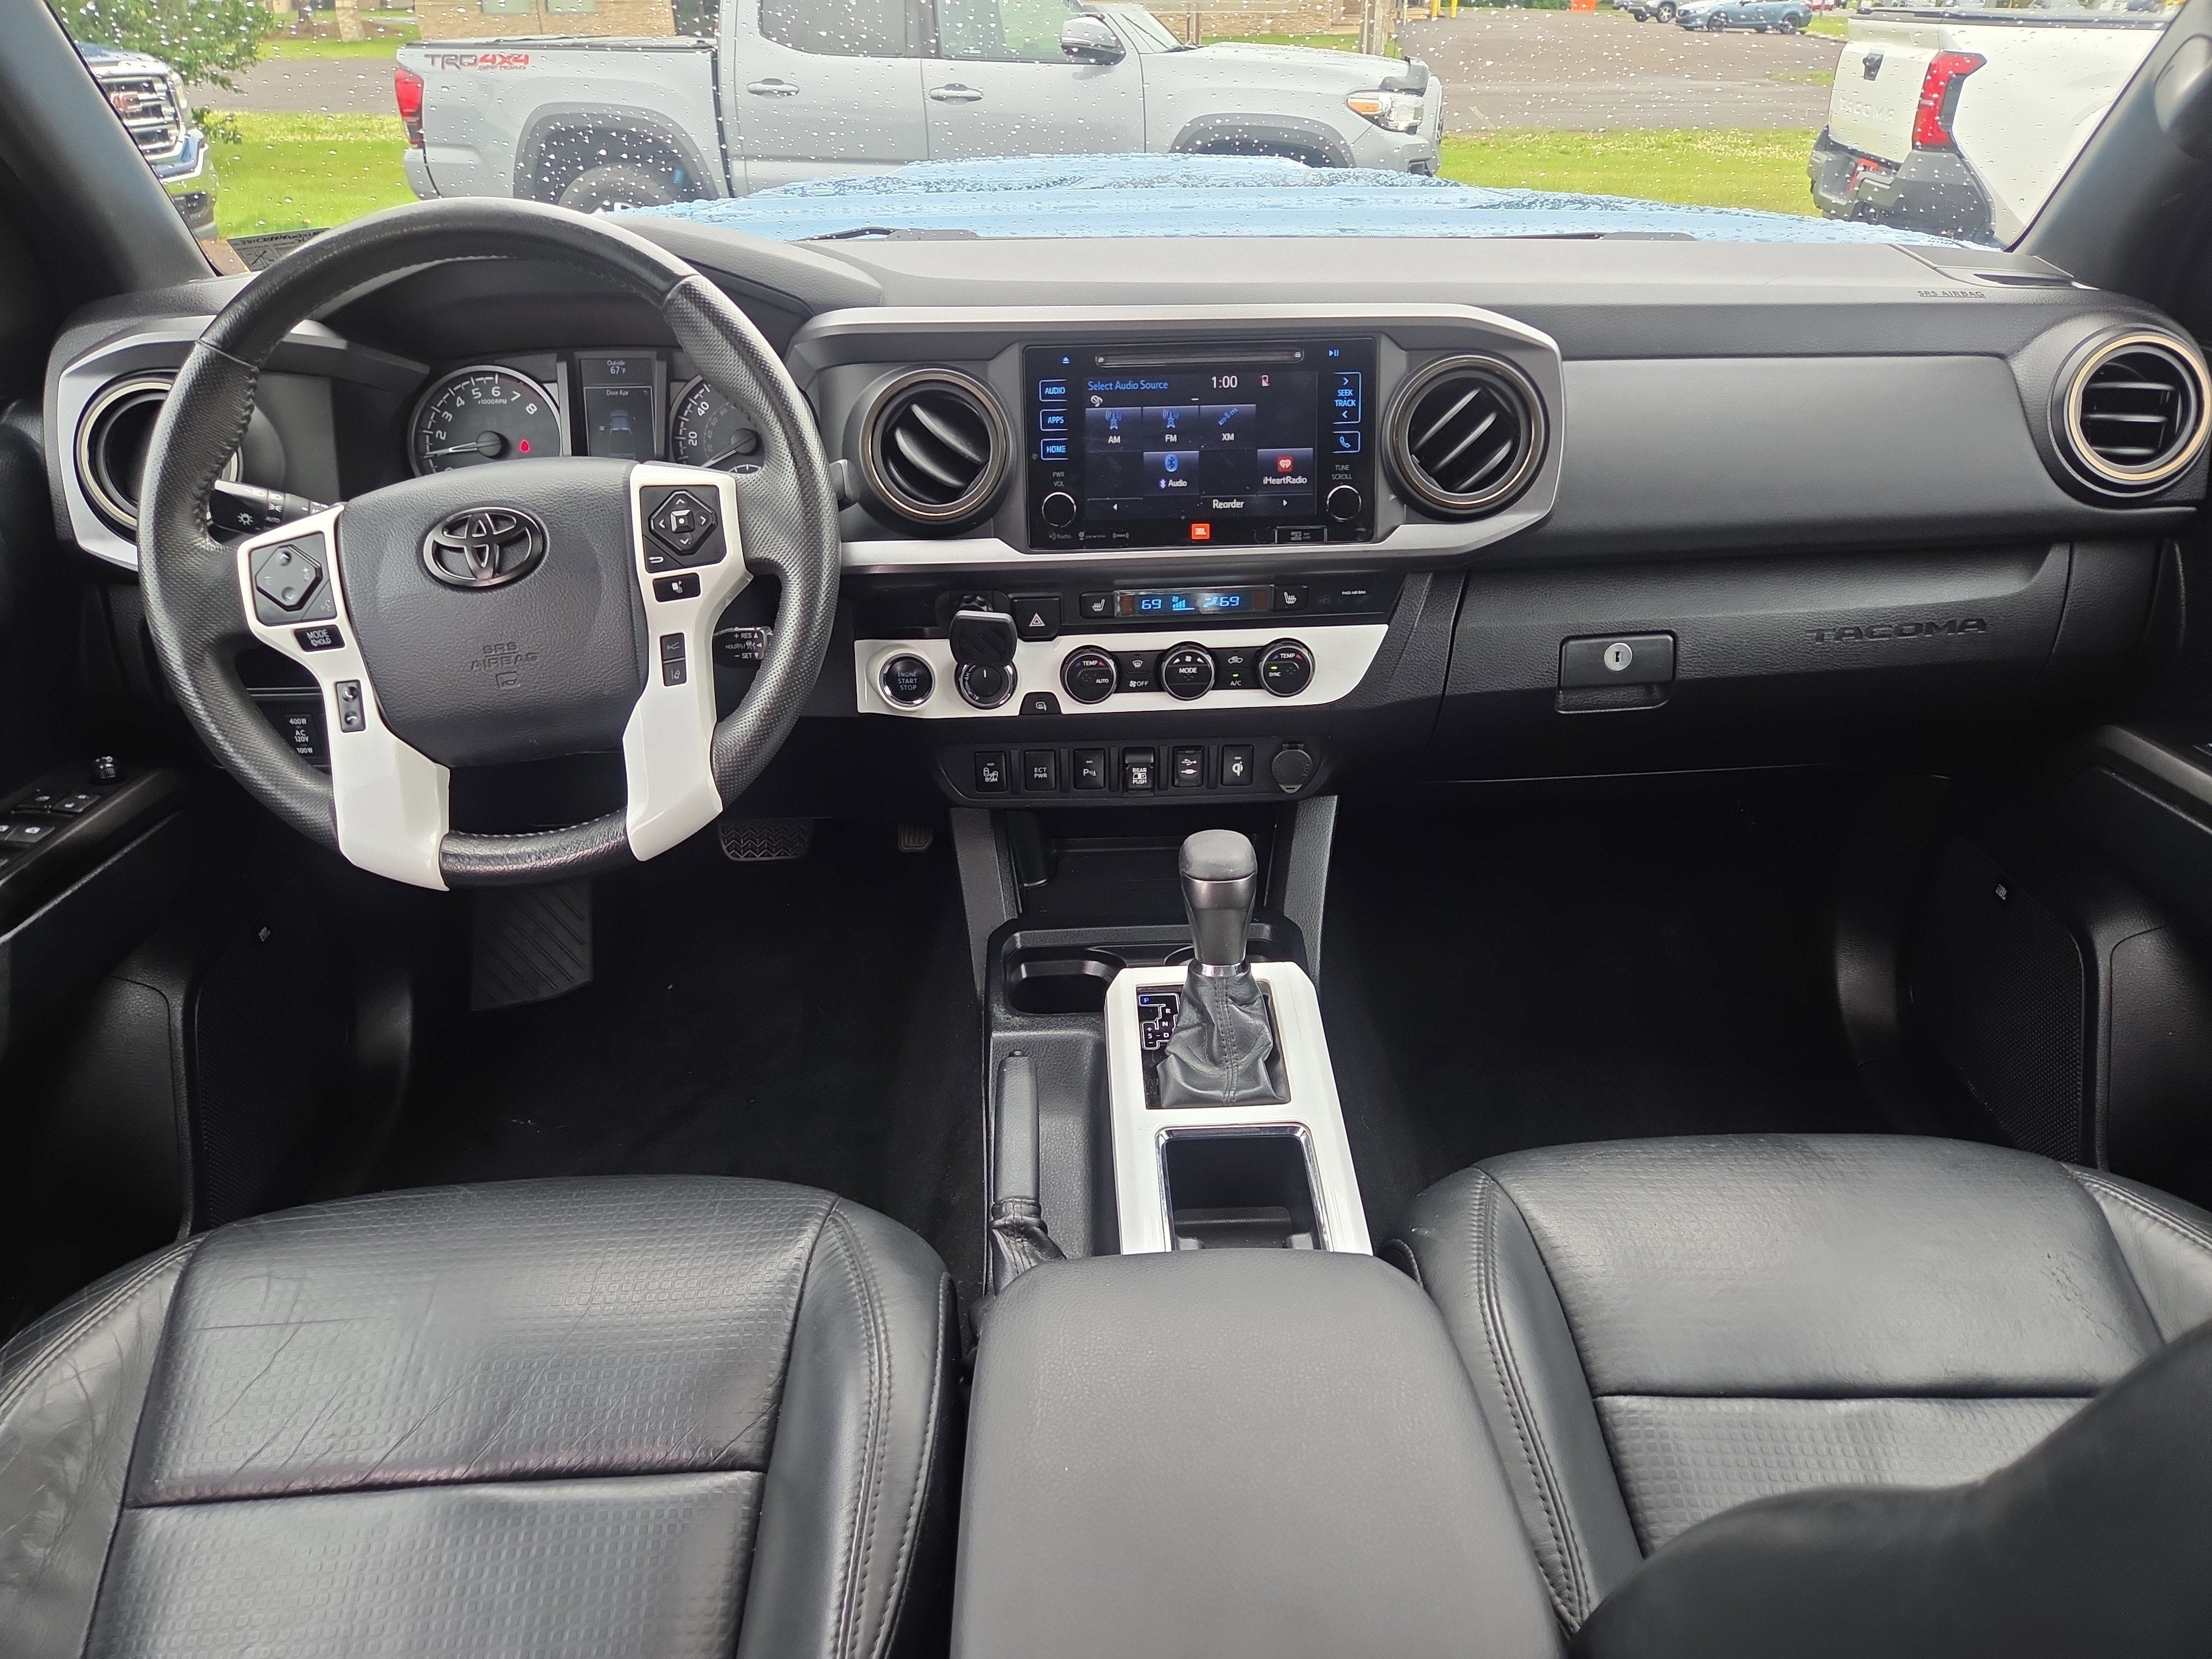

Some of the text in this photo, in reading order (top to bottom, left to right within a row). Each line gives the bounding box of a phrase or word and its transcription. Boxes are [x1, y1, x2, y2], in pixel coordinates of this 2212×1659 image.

[424, 54, 477, 70] TRD
[1088, 380, 1168, 391] Select Audio Source
[1211, 375, 1238, 389] 1:00
[471, 387, 482, 399] 5
[491, 386, 501, 397] 6
[510, 390, 522, 402] 7
[1044, 387, 1066, 395] AUDIO
[456, 396, 465, 408] 4
[1334, 399, 1356, 407] TRACK
[525, 403, 538, 415] 8
[697, 401, 710, 417] 40
[441, 410, 453, 423] 3
[1047, 416, 1064, 424] APPS
[435, 430, 447, 440] 2
[688, 431, 698, 447] 20
[1108, 435, 1121, 444] AM
[1165, 434, 1178, 443] FM
[1221, 433, 1235, 441] XM
[1046, 445, 1066, 453] HOME
[1168, 478, 1188, 487] Audio
[1263, 475, 1308, 485] iHeartRadio
[1212, 498, 1245, 509] Reorder
[1141, 596, 1240, 609] 69 69
[306, 629, 330, 639] MODE
[1805, 618, 1986, 644] TACOMA
